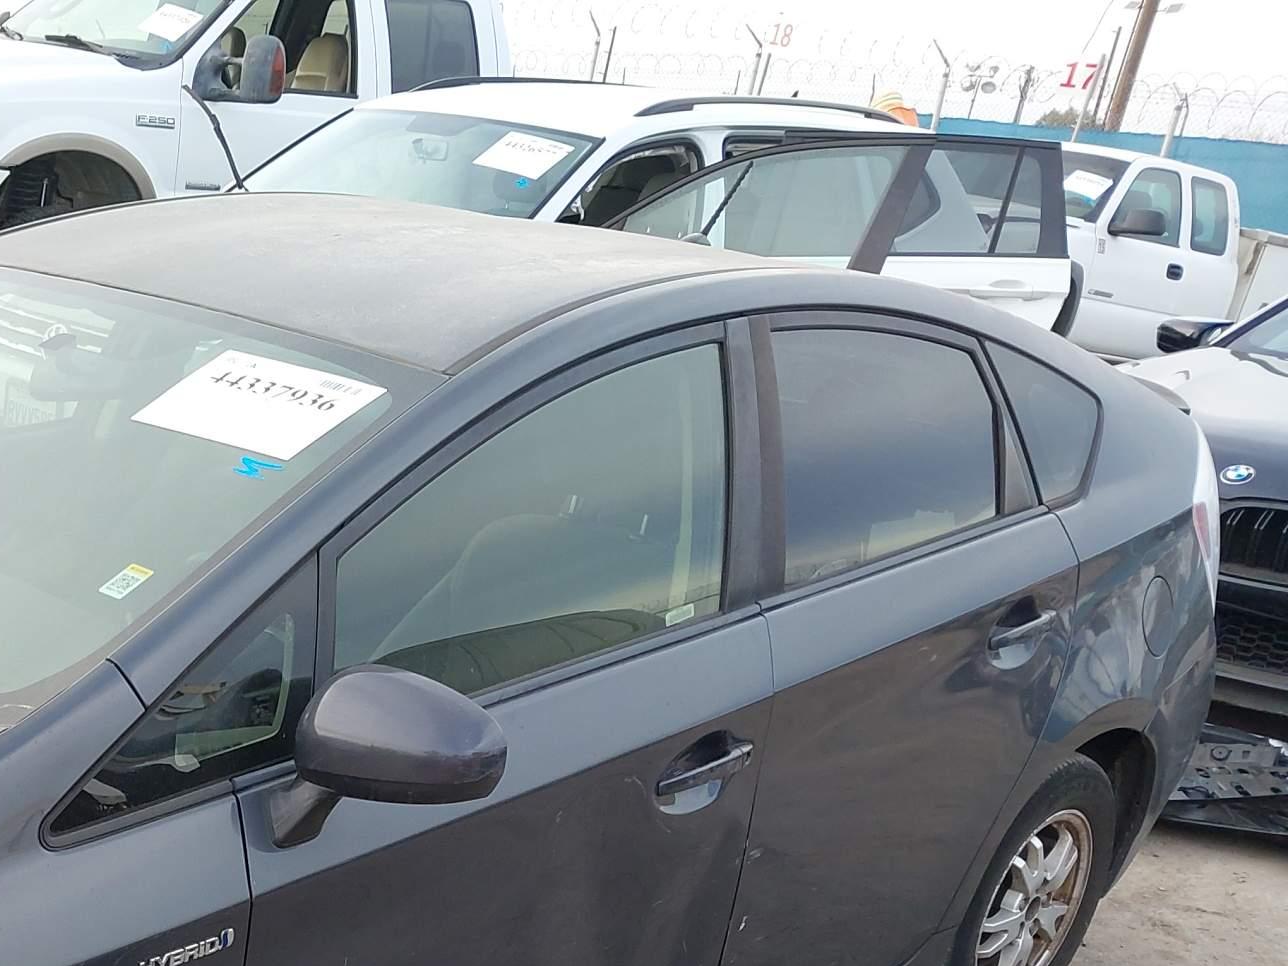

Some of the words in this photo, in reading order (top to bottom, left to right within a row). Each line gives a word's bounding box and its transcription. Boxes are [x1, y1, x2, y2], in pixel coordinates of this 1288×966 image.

[769, 23, 793, 47] 18
[1060, 62, 1100, 90] 17
[211, 371, 337, 411] 44337936
